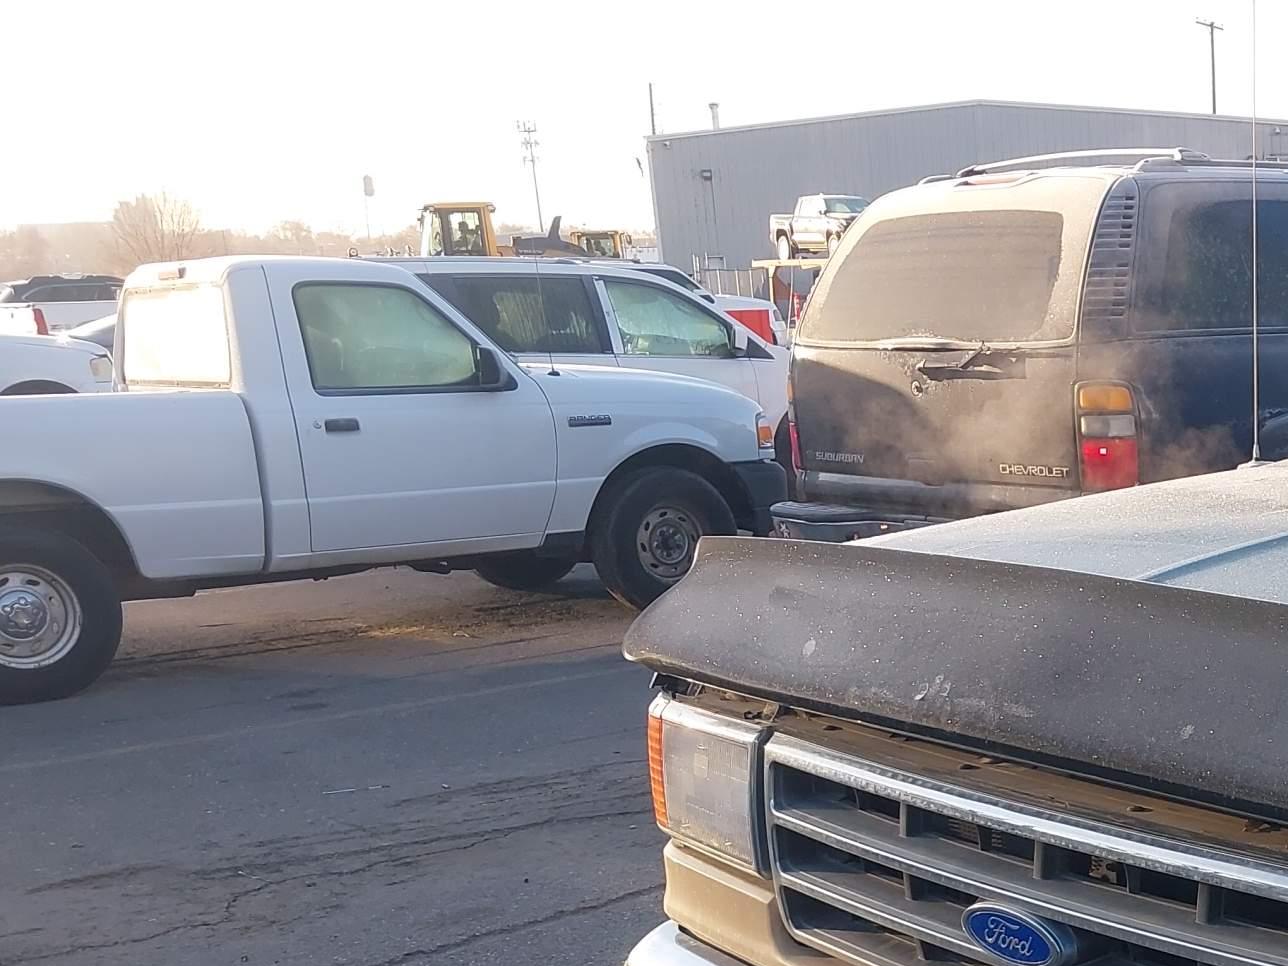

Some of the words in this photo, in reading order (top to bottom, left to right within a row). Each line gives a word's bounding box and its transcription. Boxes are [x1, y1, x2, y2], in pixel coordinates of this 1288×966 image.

[815, 451, 865, 464] SUBURBAN
[1000, 464, 1070, 478] CHEVROLET
[984, 916, 1034, 957] Ford
